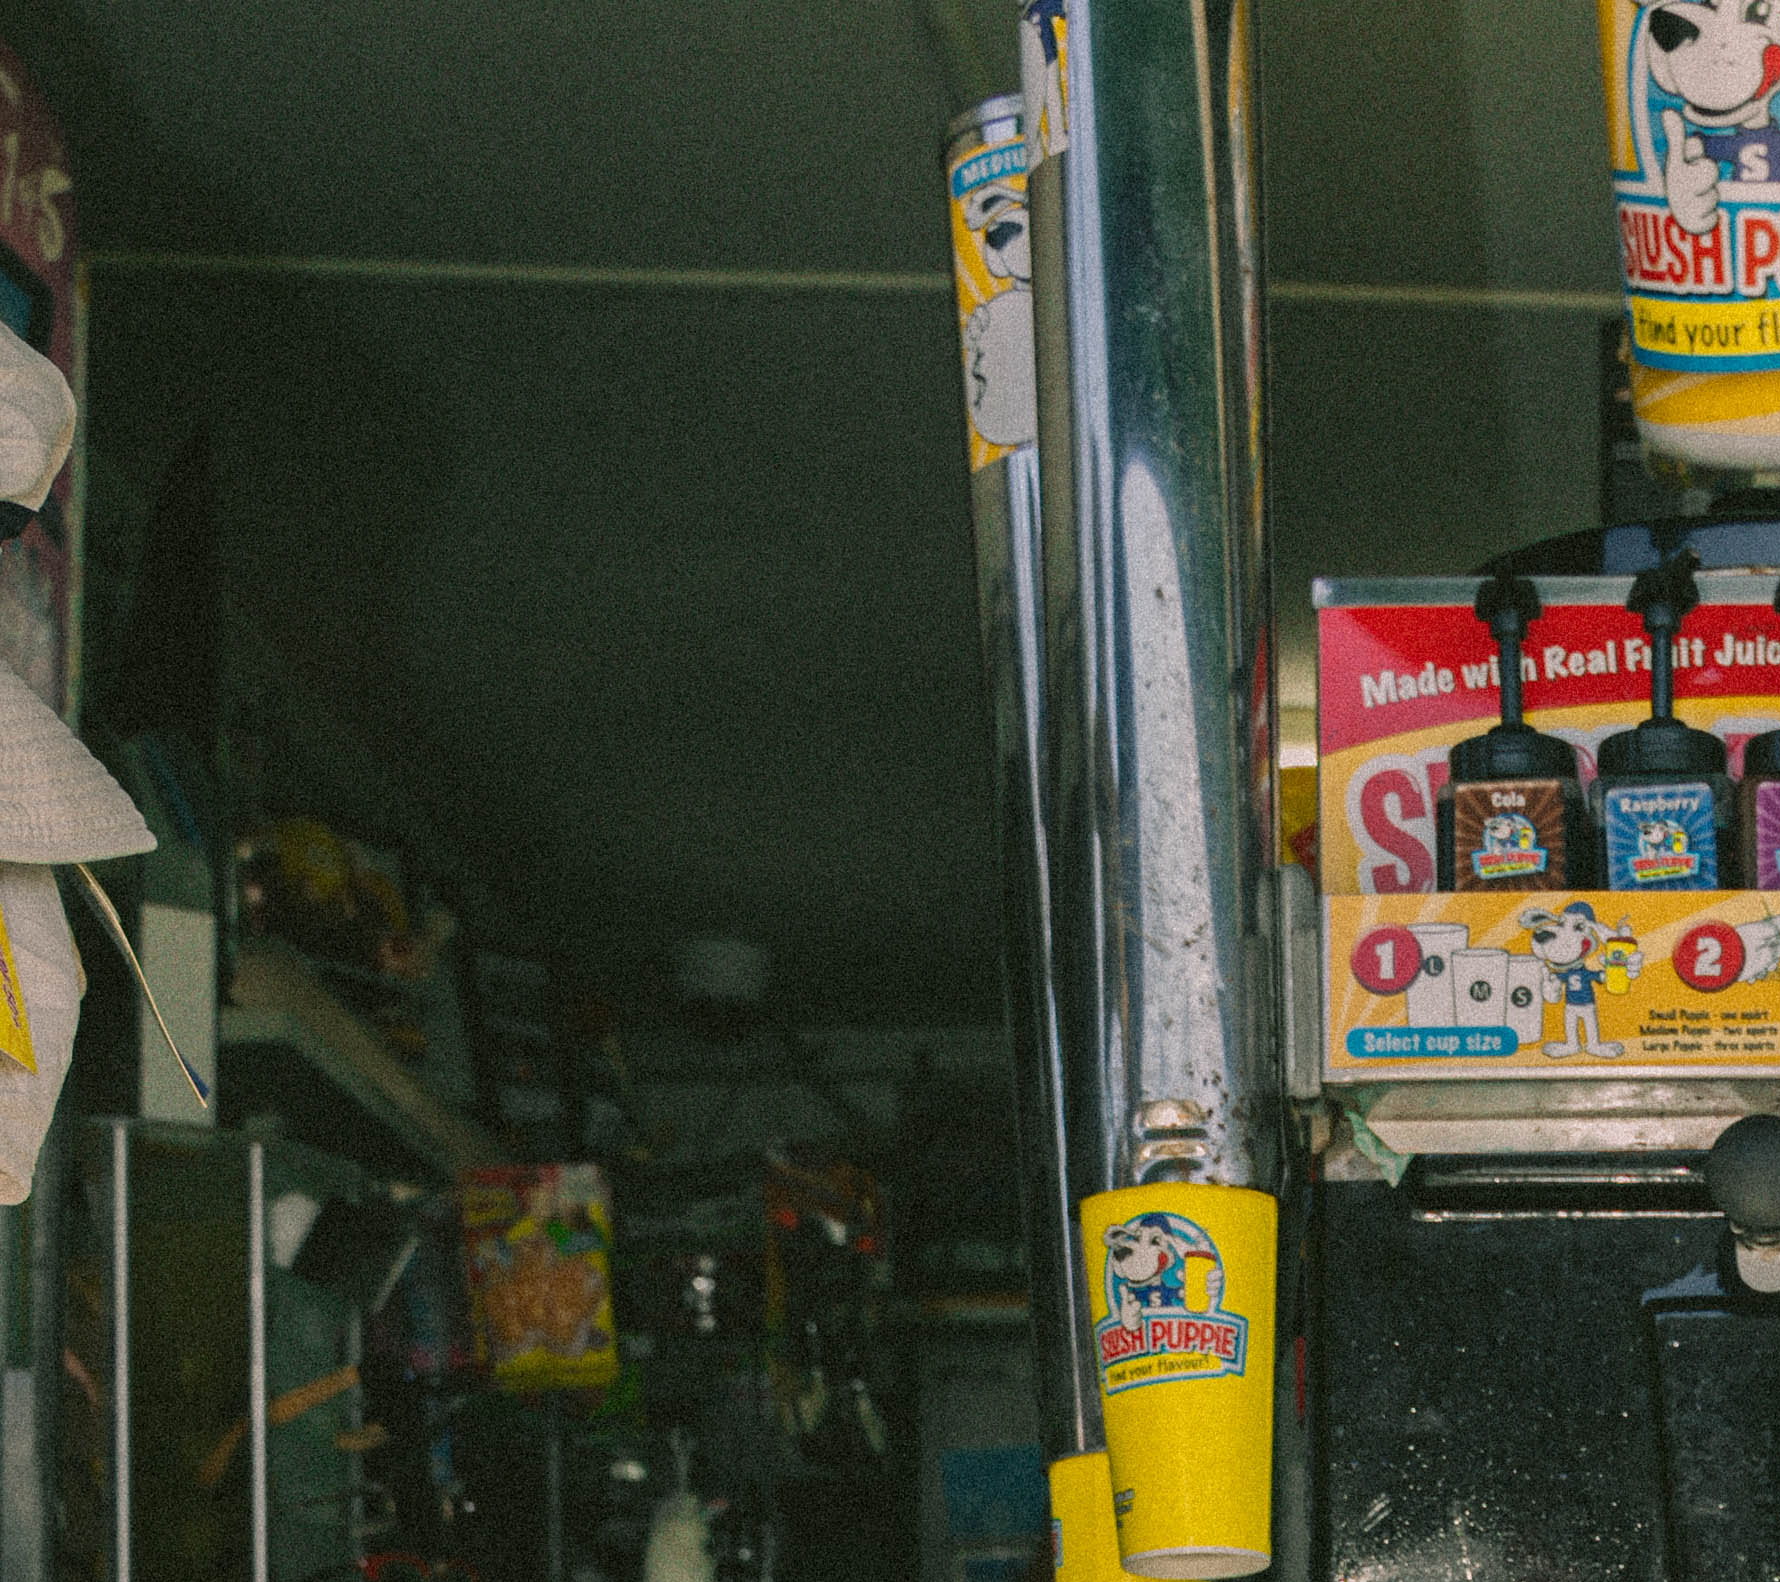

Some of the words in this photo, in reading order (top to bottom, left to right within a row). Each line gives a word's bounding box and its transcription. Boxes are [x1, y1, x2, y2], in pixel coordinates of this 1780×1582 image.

[962, 147, 1028, 187] MEDIU
[1738, 142, 1769, 183] S
[1620, 210, 1726, 285] SLUSH
[1637, 309, 1677, 345] find
[1683, 321, 1745, 354] your
[1360, 661, 1456, 709] Made
[1460, 651, 1539, 691] wih
[1543, 639, 1618, 681] Real
[1490, 790, 1527, 808] Cola
[1619, 794, 1701, 814] Raspberry
[1374, 939, 1395, 980] 1
[1695, 937, 1724, 977] 2
[1471, 984, 1490, 998] M
[1515, 989, 1528, 1006] S
[1363, 1032, 1420, 1052] Select
[1425, 1036, 1461, 1053] cup
[1466, 1033, 1502, 1052] size
